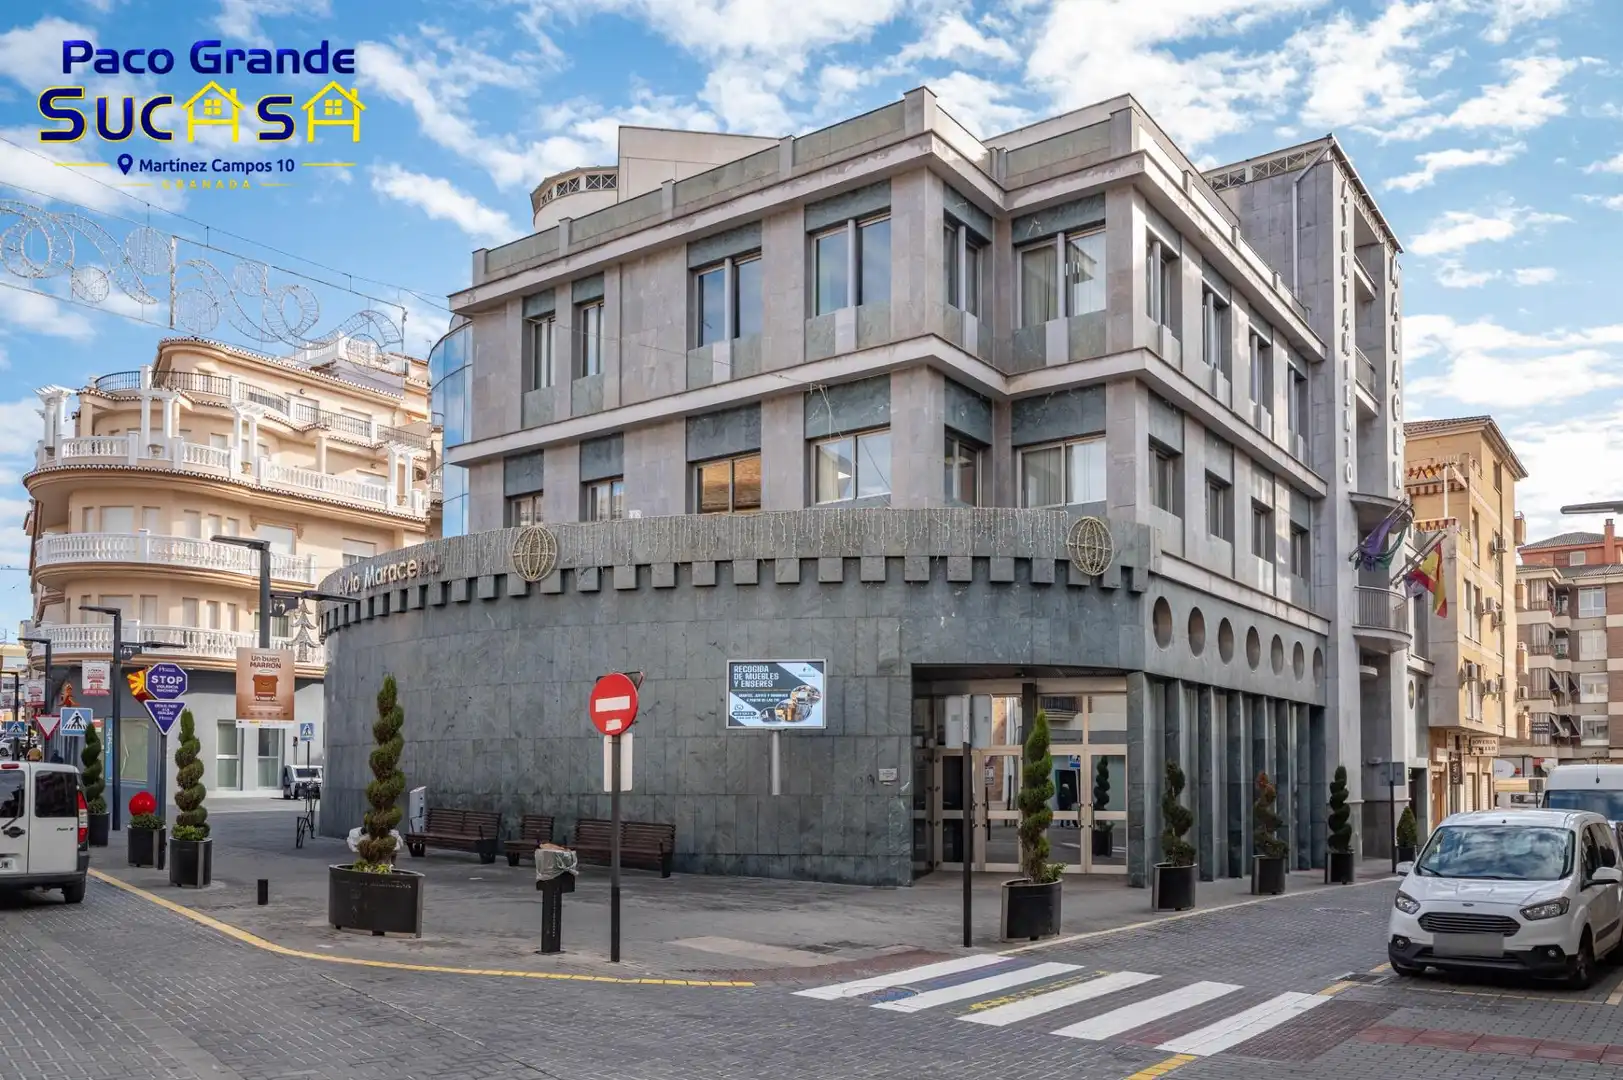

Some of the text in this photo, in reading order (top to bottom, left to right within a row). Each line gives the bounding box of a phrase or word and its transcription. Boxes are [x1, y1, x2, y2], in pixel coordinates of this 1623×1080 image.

[364, 557, 440, 588] Marace
[262, 655, 280, 663] buen
[733, 665, 769, 673] RECOGIDA
[151, 675, 183, 684] STOP
[733, 672, 780, 681] DE MUEBLES
